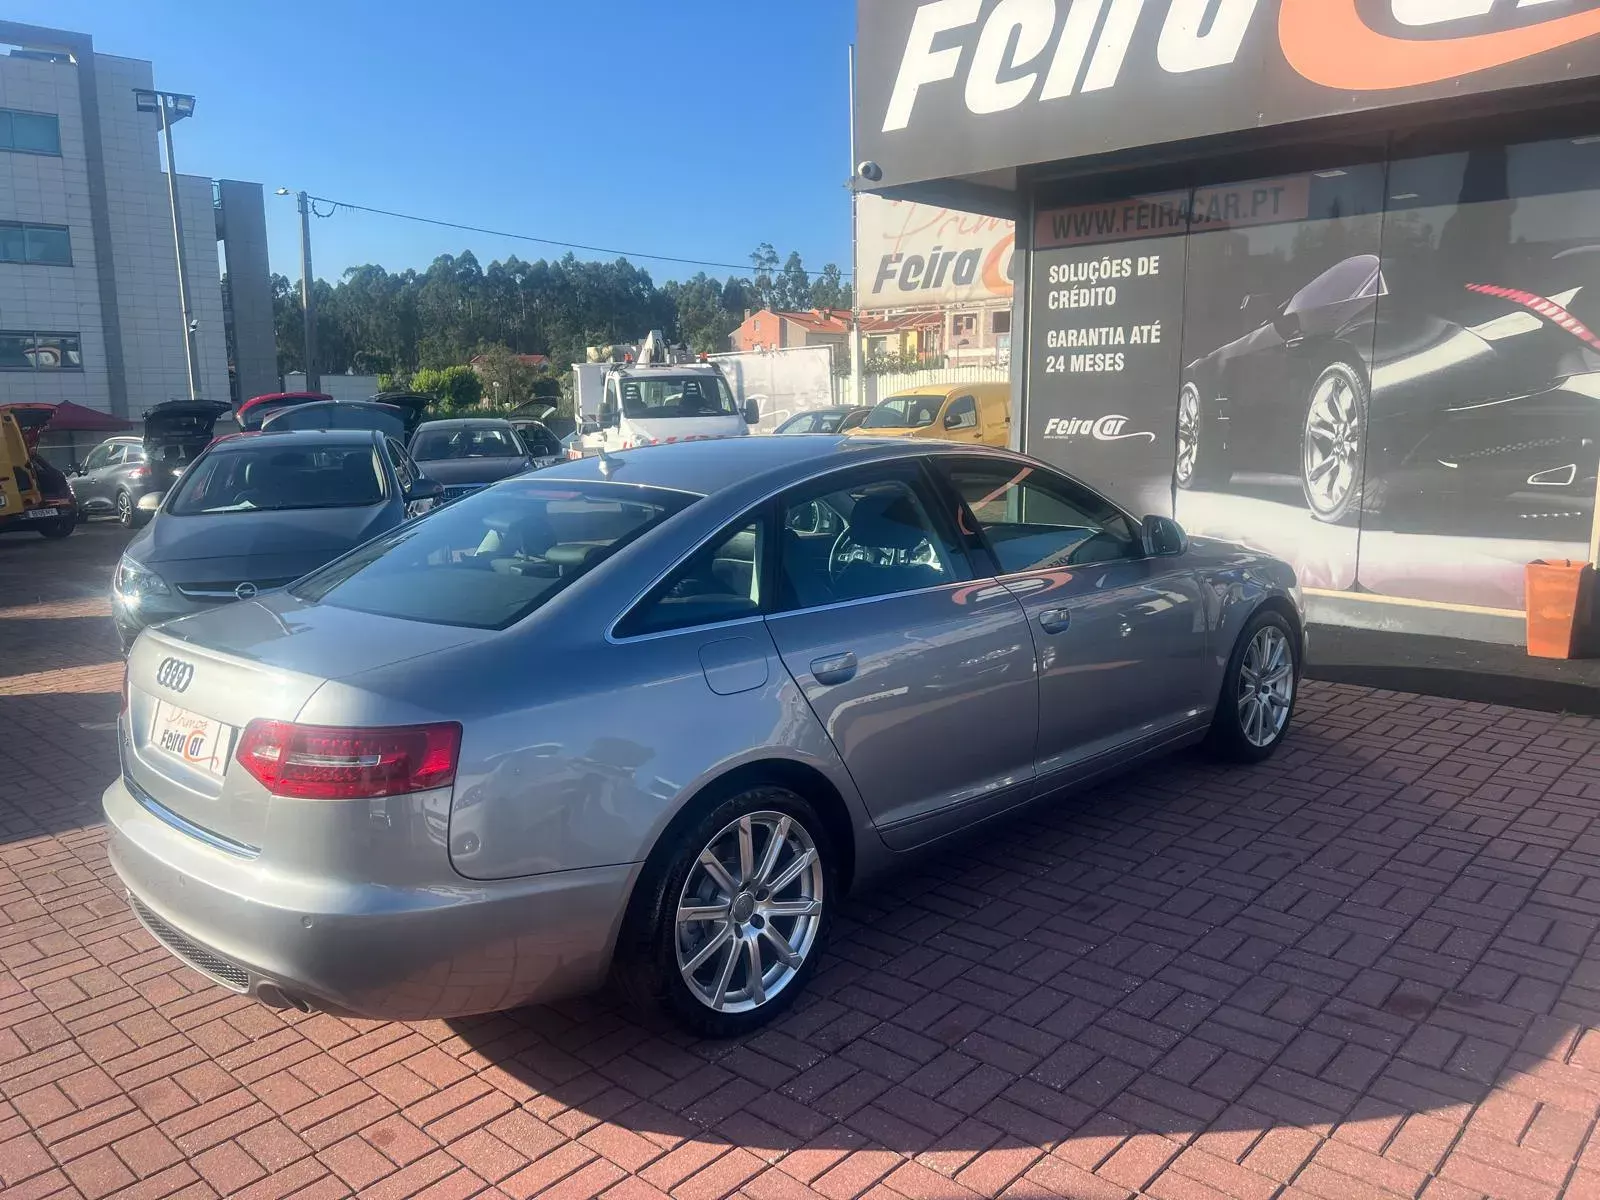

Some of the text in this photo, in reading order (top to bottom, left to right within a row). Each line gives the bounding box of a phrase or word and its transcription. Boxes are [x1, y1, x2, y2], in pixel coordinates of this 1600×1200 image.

[1053, 187, 1285, 239] WWW.FEIRACAR.PT
[1049, 256, 1160, 284] SOLUÇÕES DE
[1048, 285, 1117, 309] CRÉDITO
[1047, 320, 1161, 347] GARANTIA ATÉ
[1046, 353, 1125, 373] 24 MESES
[1044, 415, 1155, 441] FeiraCar
